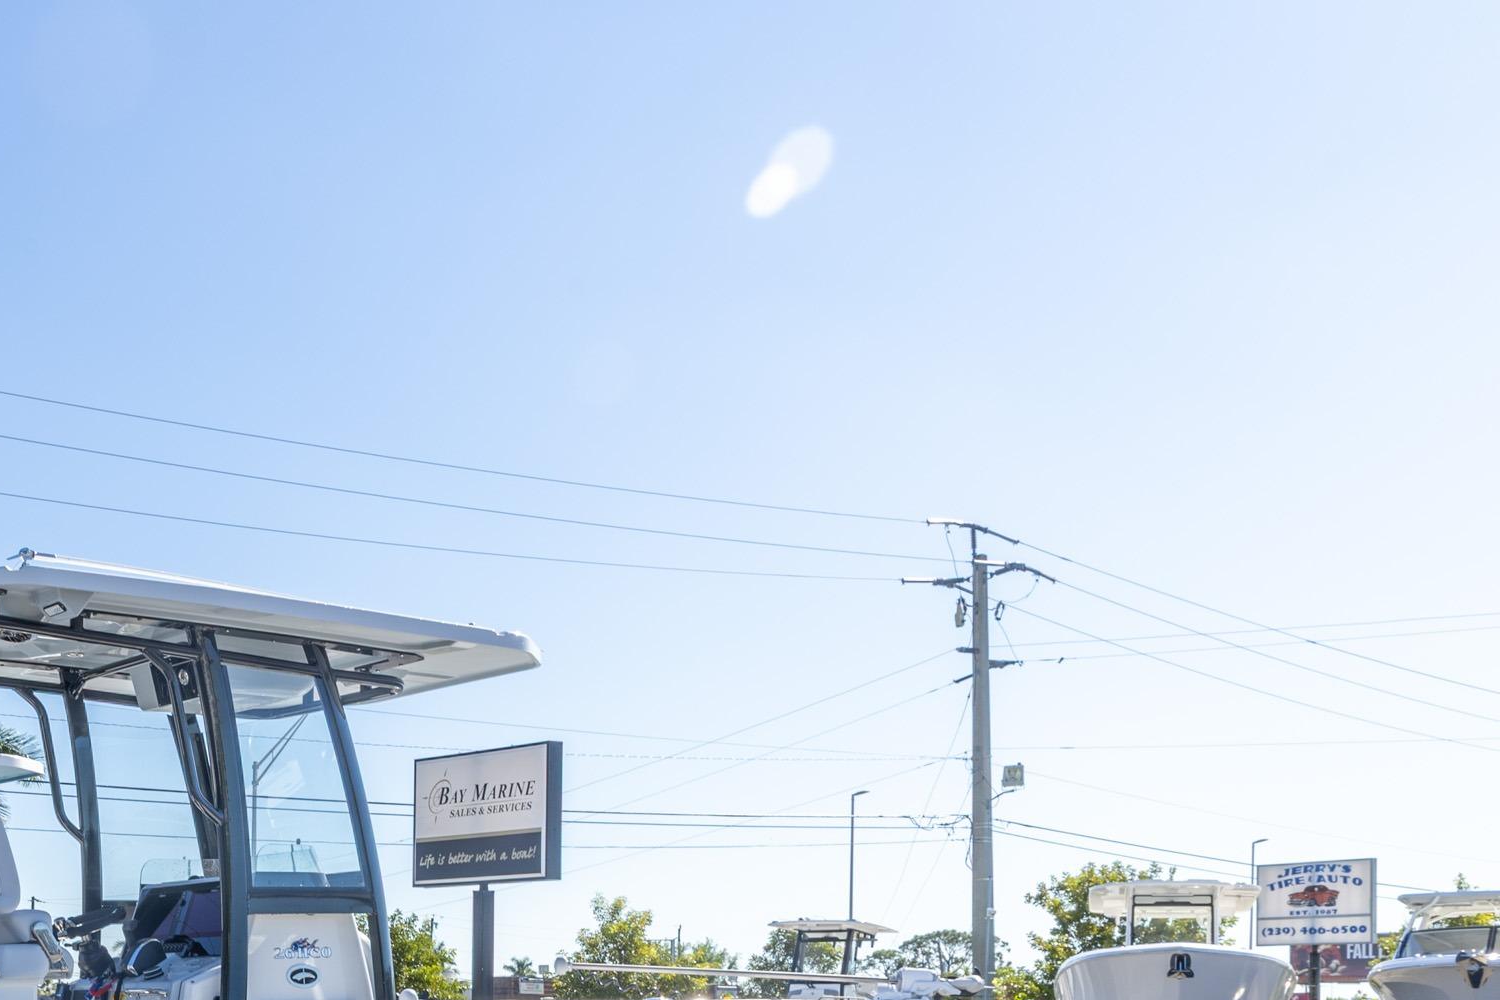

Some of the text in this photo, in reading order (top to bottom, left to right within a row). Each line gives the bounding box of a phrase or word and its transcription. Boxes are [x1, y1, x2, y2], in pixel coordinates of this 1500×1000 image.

[439, 780, 536, 806] BAY MARINE
[449, 801, 533, 818] SALES & SERVICES
[419, 845, 537, 869] Life is better with a boat!
[1278, 864, 1351, 878] JERRY'S
[1267, 875, 1305, 891] TIRE
[1316, 874, 1363, 886] AUTO
[1262, 927, 1296, 937] (239)
[1346, 943, 1376, 959] FALL
